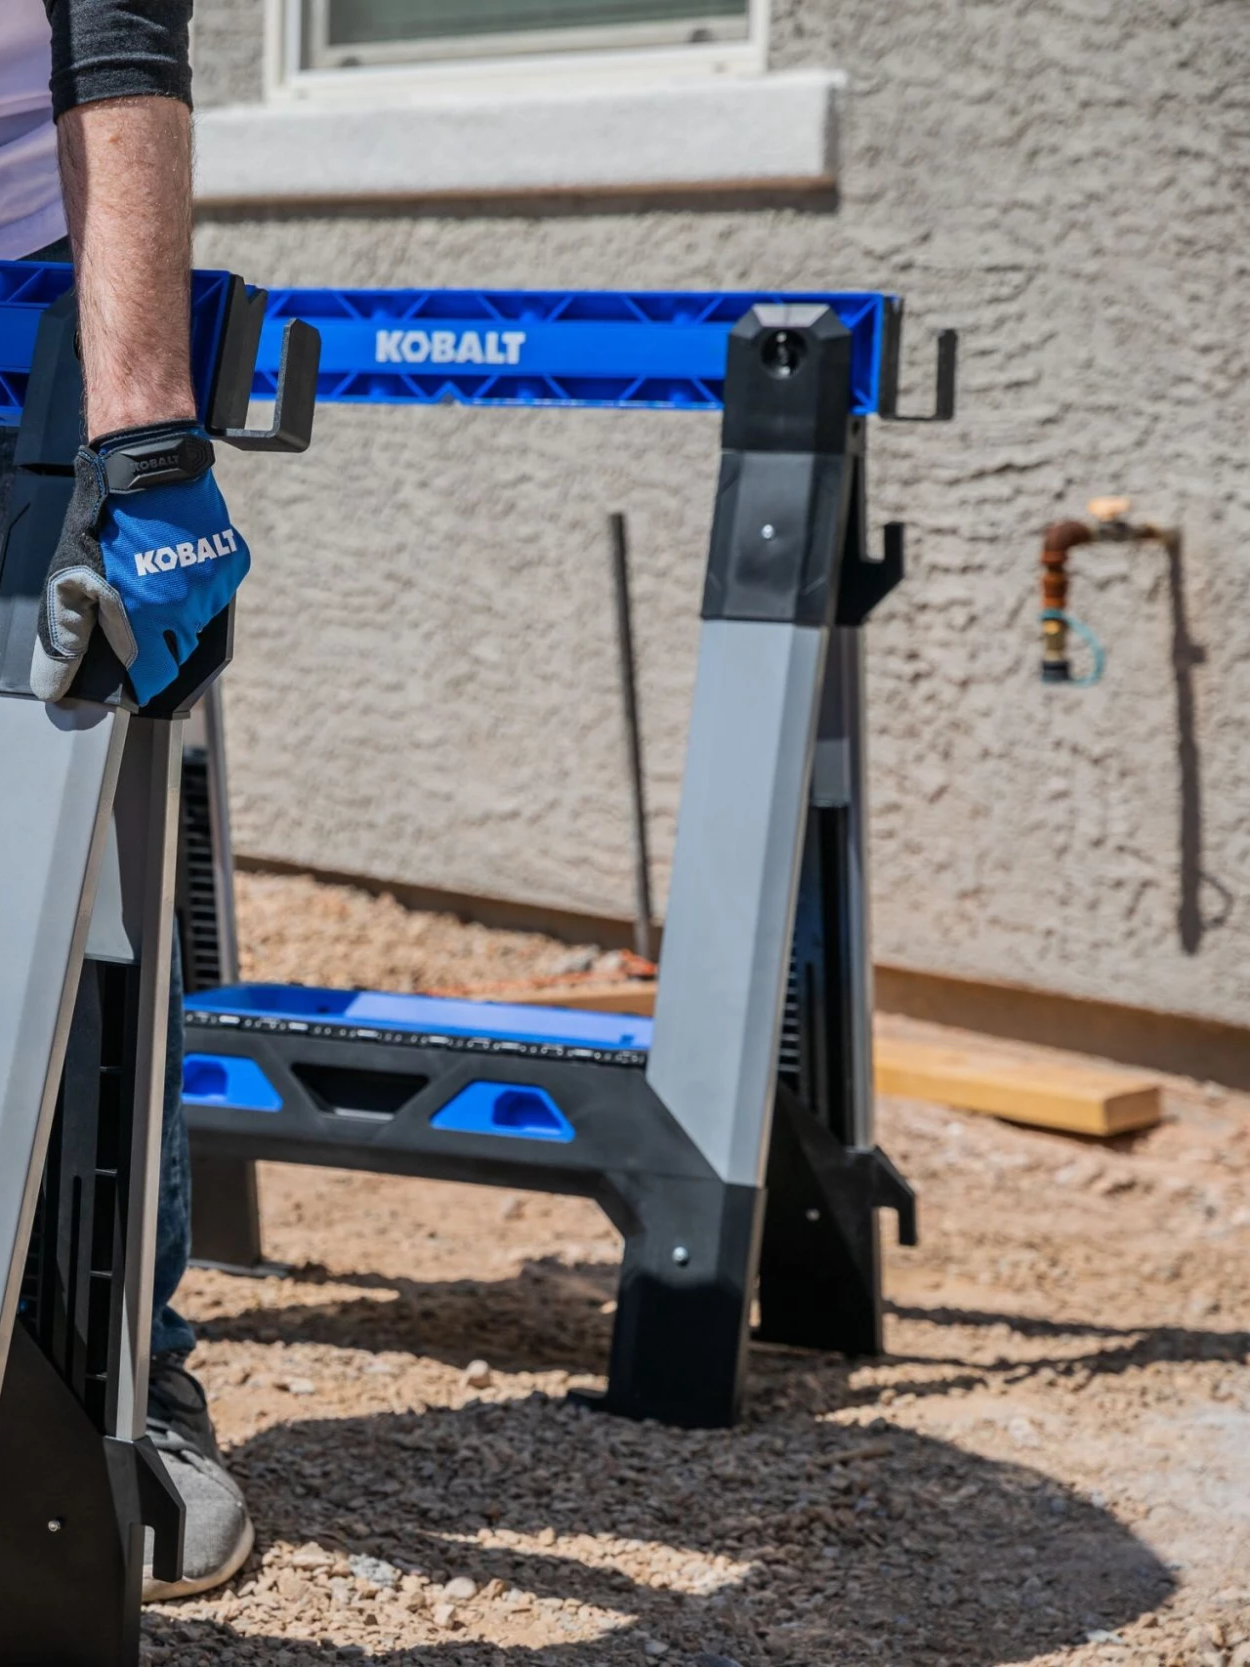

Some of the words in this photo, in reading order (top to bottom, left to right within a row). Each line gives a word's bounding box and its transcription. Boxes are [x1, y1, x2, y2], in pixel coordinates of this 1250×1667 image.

[375, 330, 526, 364] KOBALT
[129, 455, 180, 473] KOBALT
[134, 528, 237, 577] KOBALT
